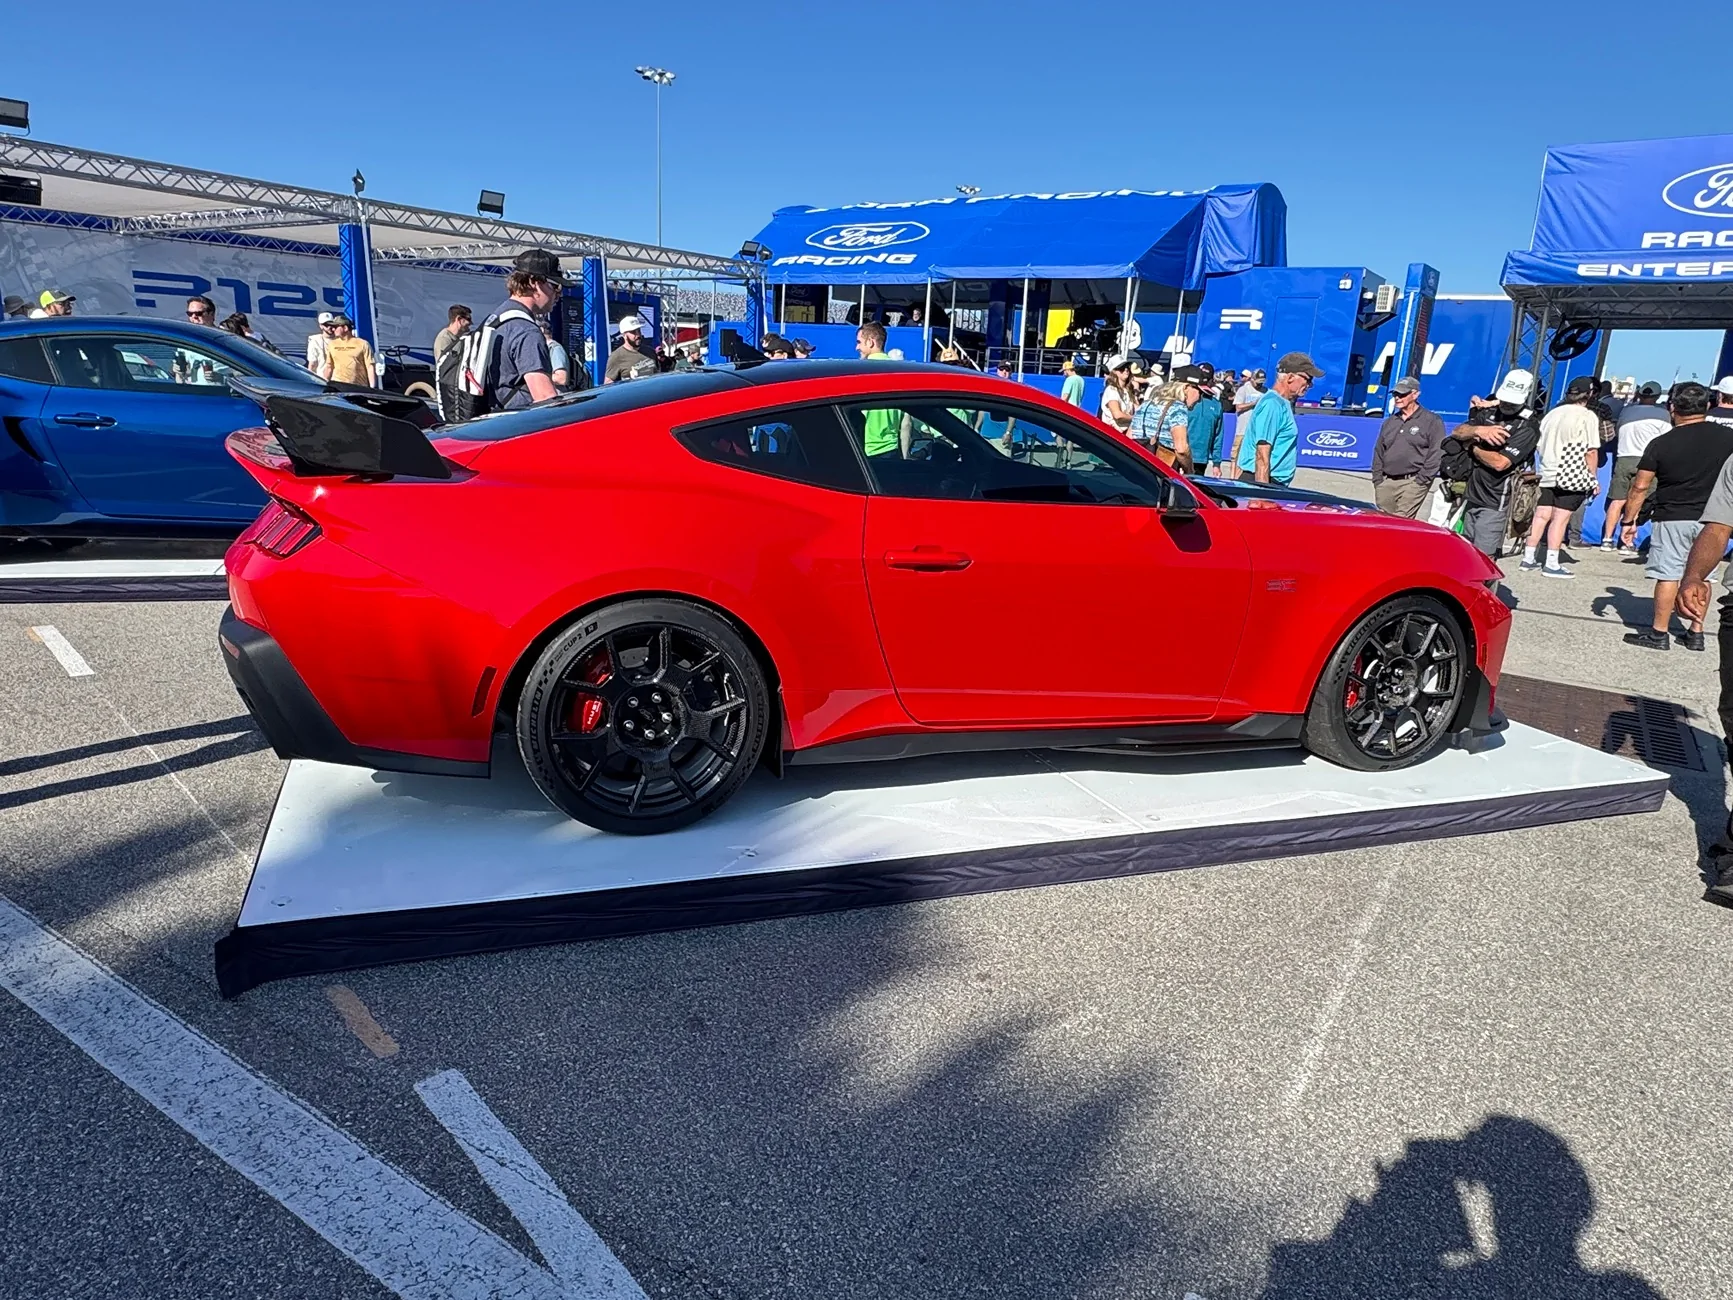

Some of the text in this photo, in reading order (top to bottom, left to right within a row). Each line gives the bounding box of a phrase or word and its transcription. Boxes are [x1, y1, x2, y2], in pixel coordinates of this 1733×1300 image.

[823, 226, 907, 247] Ford
[772, 253, 917, 266] RACING
[1315, 432, 1348, 446] Ford
[1301, 449, 1358, 459] RACING
[531, 688, 544, 750] MICHELIN
